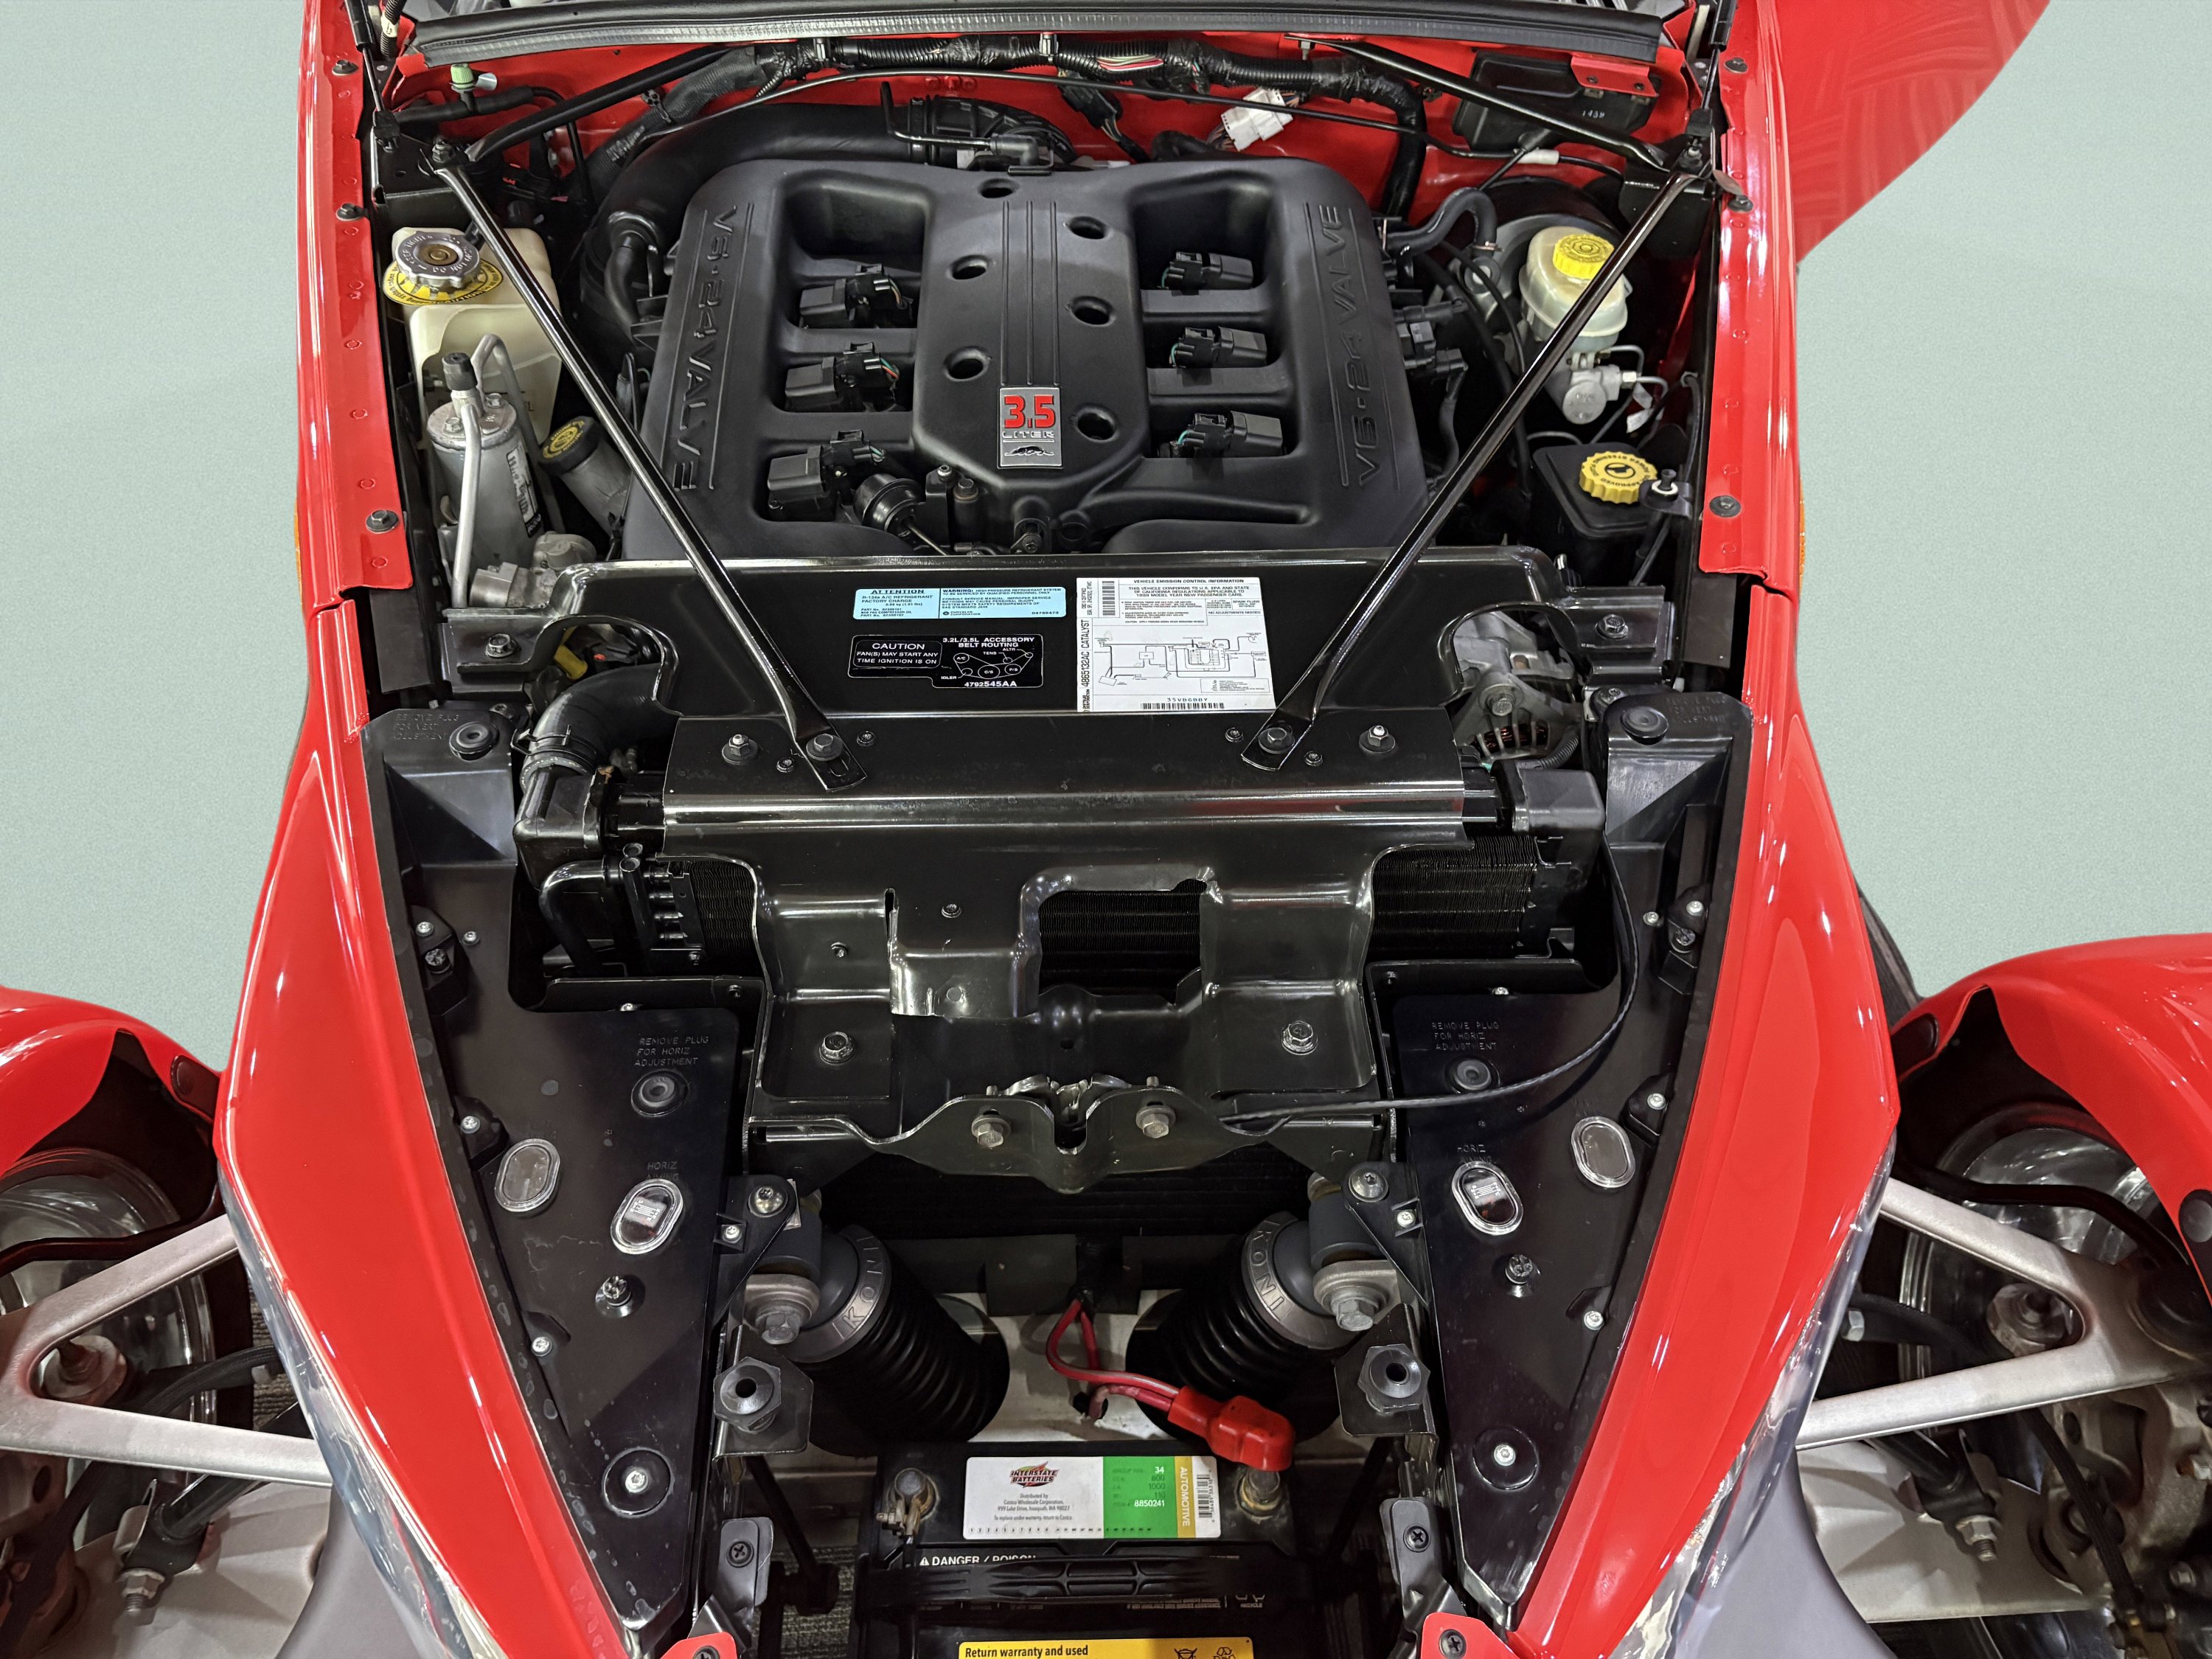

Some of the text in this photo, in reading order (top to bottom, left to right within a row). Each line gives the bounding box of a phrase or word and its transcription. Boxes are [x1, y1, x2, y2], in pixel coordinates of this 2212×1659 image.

[1004, 394, 1056, 428] 3.5
[1002, 431, 1055, 439] LITER
[1081, 619, 1090, 649] CATALYST
[1476, 1021, 1499, 1029] PLUG
[639, 1036, 709, 1046] REMOVE PLUG
[636, 1047, 691, 1056] FOR HORIZ
[634, 1057, 699, 1067] ADJUSTMENT
[842, 1246, 883, 1329] KONI
[1180, 1467, 1191, 1526] AUTOMOTIVE
[965, 1645, 1088, 1658] Return warranty and used
